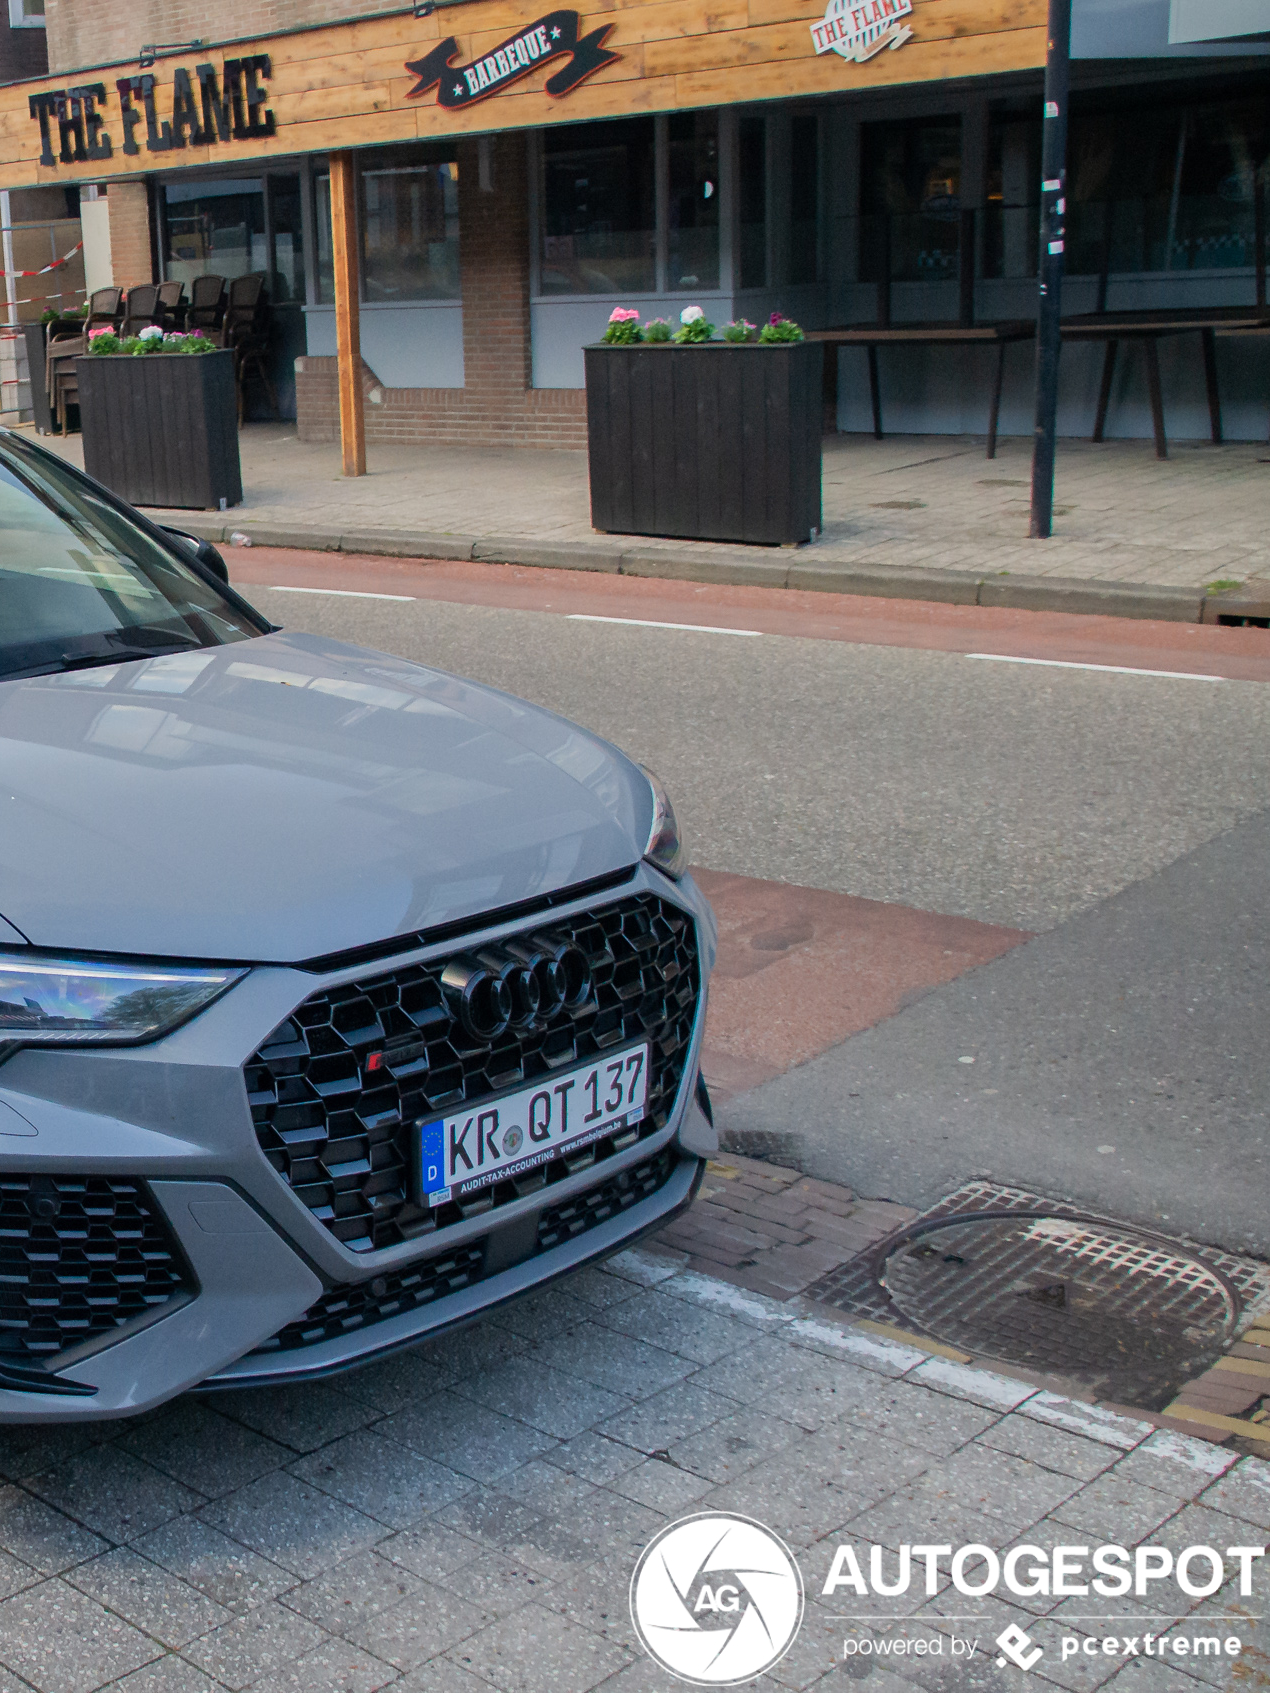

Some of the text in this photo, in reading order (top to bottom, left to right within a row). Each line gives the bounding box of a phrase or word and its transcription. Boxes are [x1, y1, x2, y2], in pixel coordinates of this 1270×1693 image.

[463, 24, 552, 96] BARBEQUE
[813, 17, 848, 48] THE
[28, 53, 277, 167] THE FLAME
[449, 1051, 644, 1177] KR QT 137
[427, 1165, 438, 1182] D
[460, 1149, 555, 1194] AUDIT-TAX-ACCOUNTING
